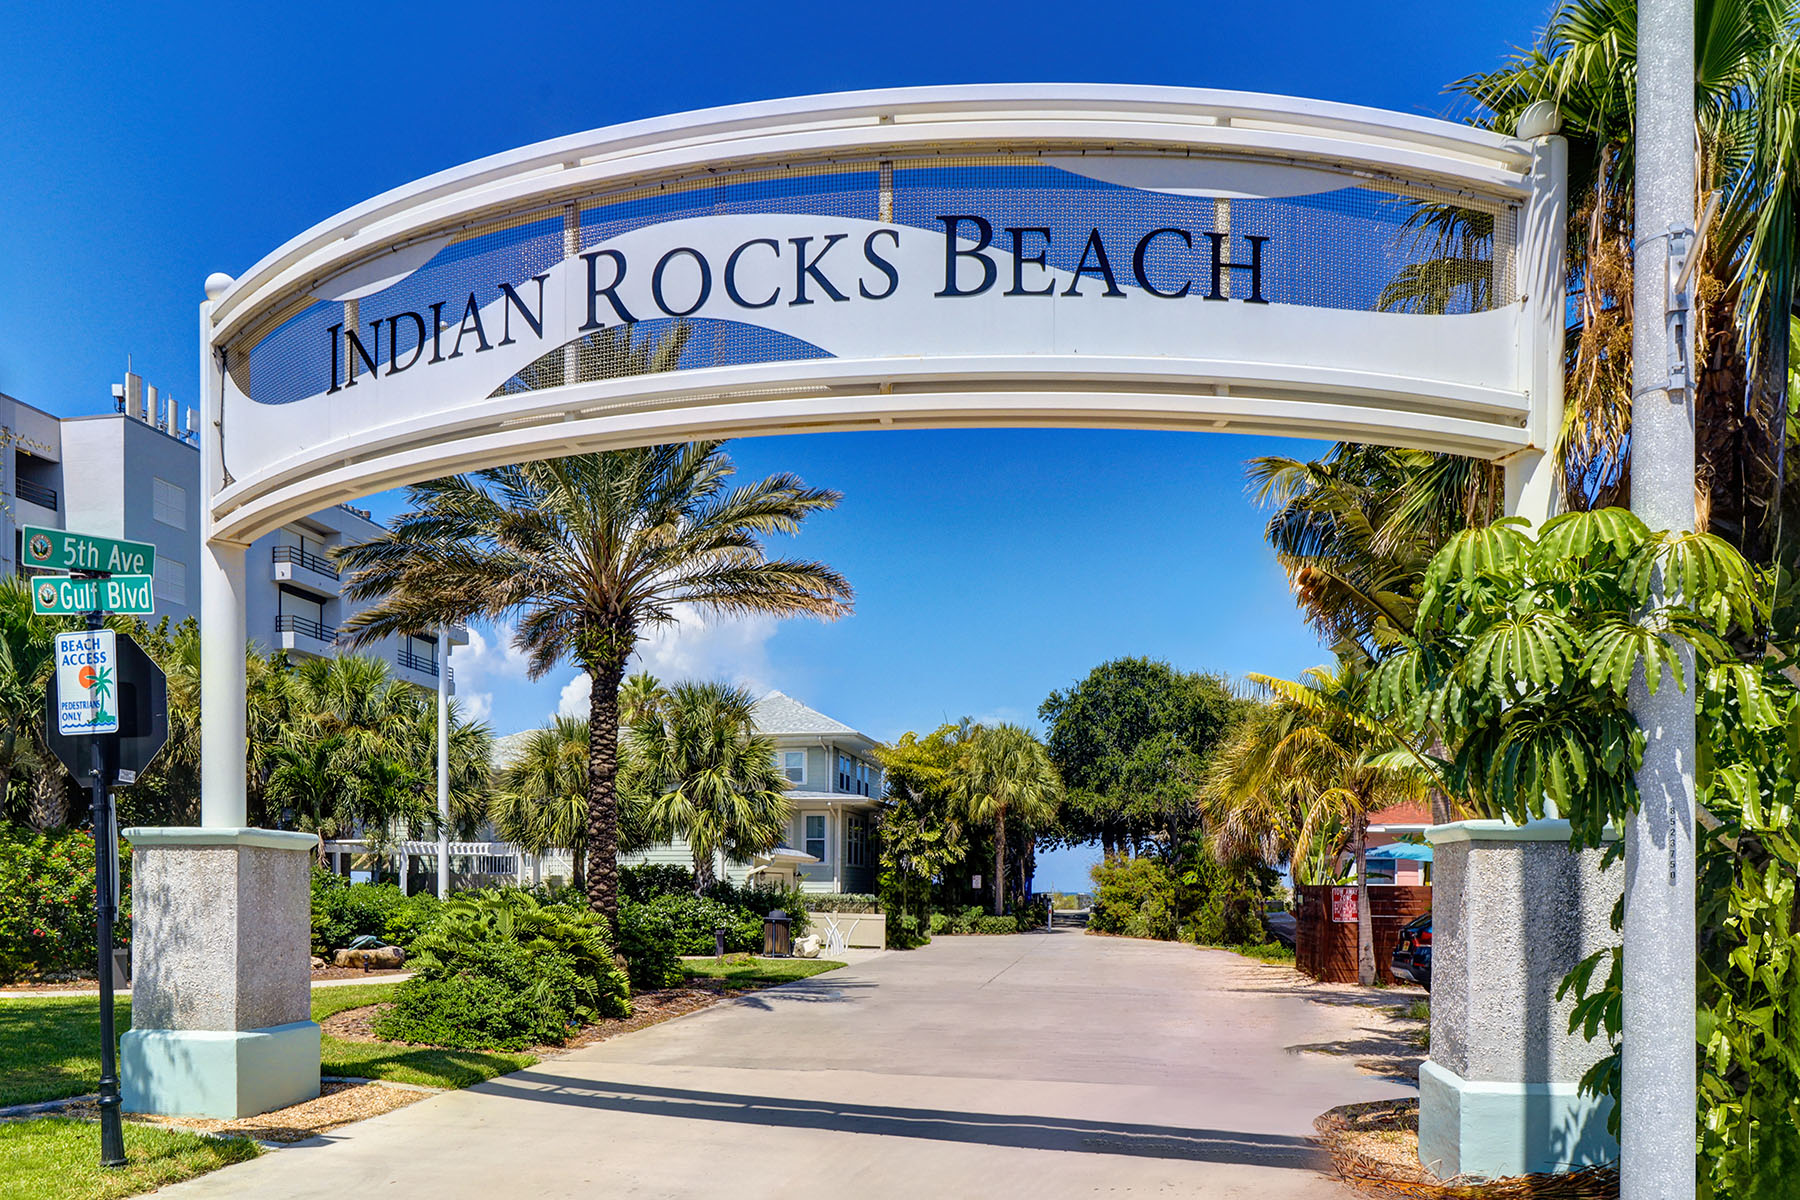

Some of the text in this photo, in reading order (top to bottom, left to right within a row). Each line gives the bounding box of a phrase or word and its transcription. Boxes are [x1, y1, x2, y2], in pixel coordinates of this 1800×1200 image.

[325, 215, 1270, 396] INDIAN ROCKS BEACH
[63, 537, 99, 568] 5th
[107, 544, 145, 574] Ave
[60, 581, 98, 609] Gulf
[107, 581, 150, 609] Blvd
[61, 638, 100, 653] BEACH
[62, 651, 107, 666] ACCESS
[61, 700, 101, 710] PEDESTRIANS
[62, 711, 82, 721] ONLY
